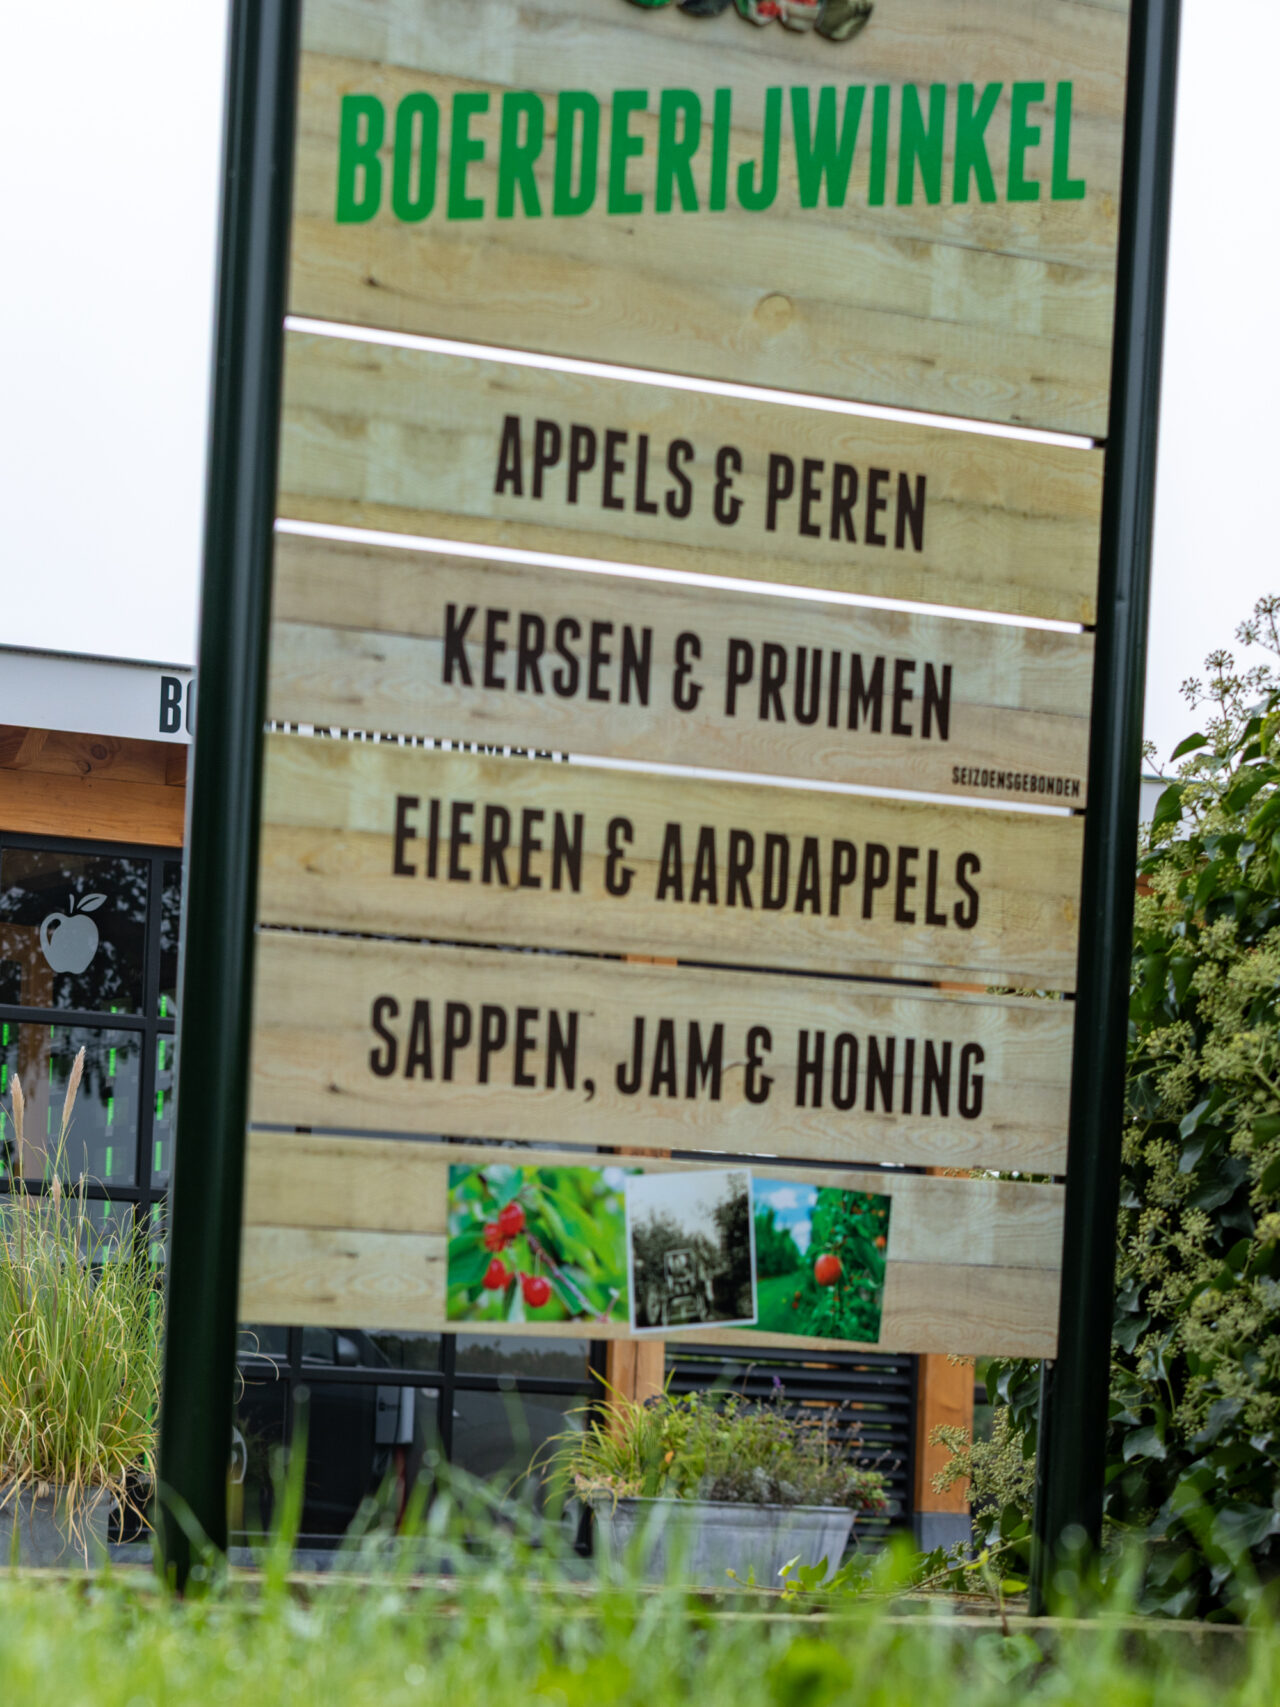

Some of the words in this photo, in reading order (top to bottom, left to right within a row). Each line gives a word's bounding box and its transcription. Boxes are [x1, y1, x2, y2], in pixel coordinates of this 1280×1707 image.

[336, 81, 1086, 223] BOERDERIJWINKEL
[494, 414, 695, 519] APPELS
[713, 445, 744, 526] &
[765, 452, 927, 553] PEREN
[442, 603, 653, 707] KERSEN
[672, 631, 703, 712] &
[725, 637, 953, 742] PRUIMEN
[951, 766, 1080, 797] SEIZOENSGEBONDEN
[393, 795, 584, 893] EIEREN
[604, 816, 636, 897] &
[655, 822, 981, 931] AARDAPPELS
[369, 995, 596, 1101] SAPPEN,
[615, 1016, 725, 1101] JAM
[743, 1025, 775, 1105] &
[795, 1029, 985, 1120] HONING
